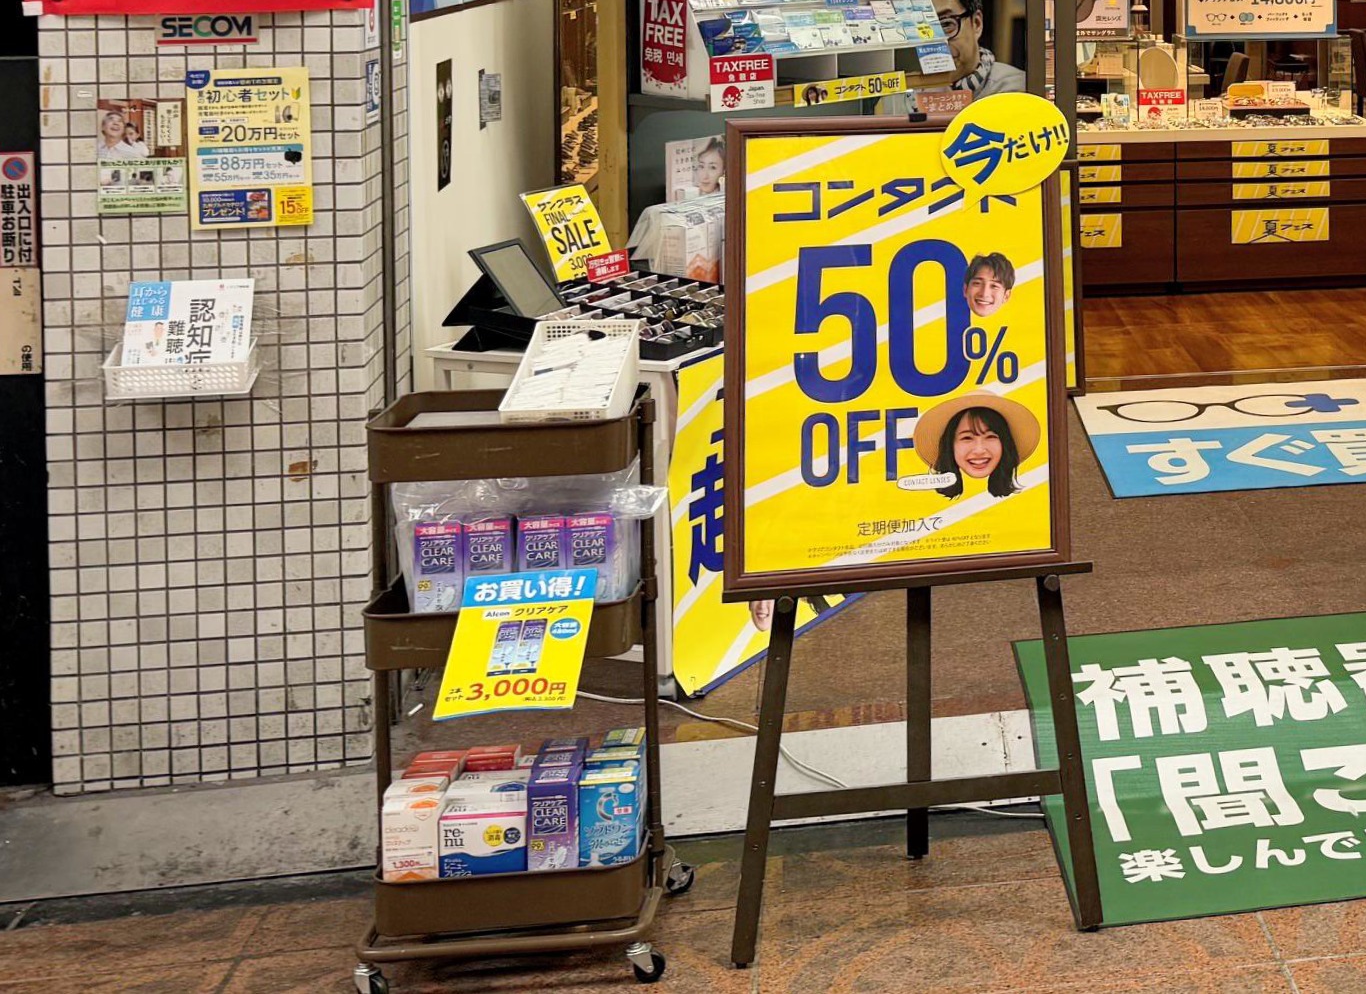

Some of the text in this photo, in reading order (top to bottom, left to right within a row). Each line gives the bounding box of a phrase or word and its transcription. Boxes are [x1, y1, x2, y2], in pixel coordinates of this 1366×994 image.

[161, 16, 253, 38] SECOM
[645, 23, 684, 48] FREE
[714, 59, 769, 73] TAXFREE
[1141, 91, 1182, 99] TAXFREE
[943, 122, 1069, 185] 今だけ!!
[17, 184, 32, 263] 出入口に付
[544, 210, 571, 226] FINAL
[551, 219, 601, 255] SALE
[130, 306, 164, 317] 健康
[166, 320, 186, 354] 難聴
[801, 407, 919, 488] OFF
[857, 516, 944, 536] 定期便加入で
[470, 544, 503, 553] CLEAR
[526, 542, 558, 551] CLEAR
[573, 538, 605, 547] CLEAR
[421, 547, 455, 556] CLEAR
[526, 552, 558, 561] CARE
[573, 548, 605, 557] CARE
[421, 558, 455, 567] CARE
[470, 554, 503, 563] CARE
[474, 576, 587, 602] お買い得!
[515, 605, 569, 617] クリアケア
[465, 678, 567, 701] 3,000円
[533, 807, 566, 816] CLEAR
[533, 817, 566, 826] CARE
